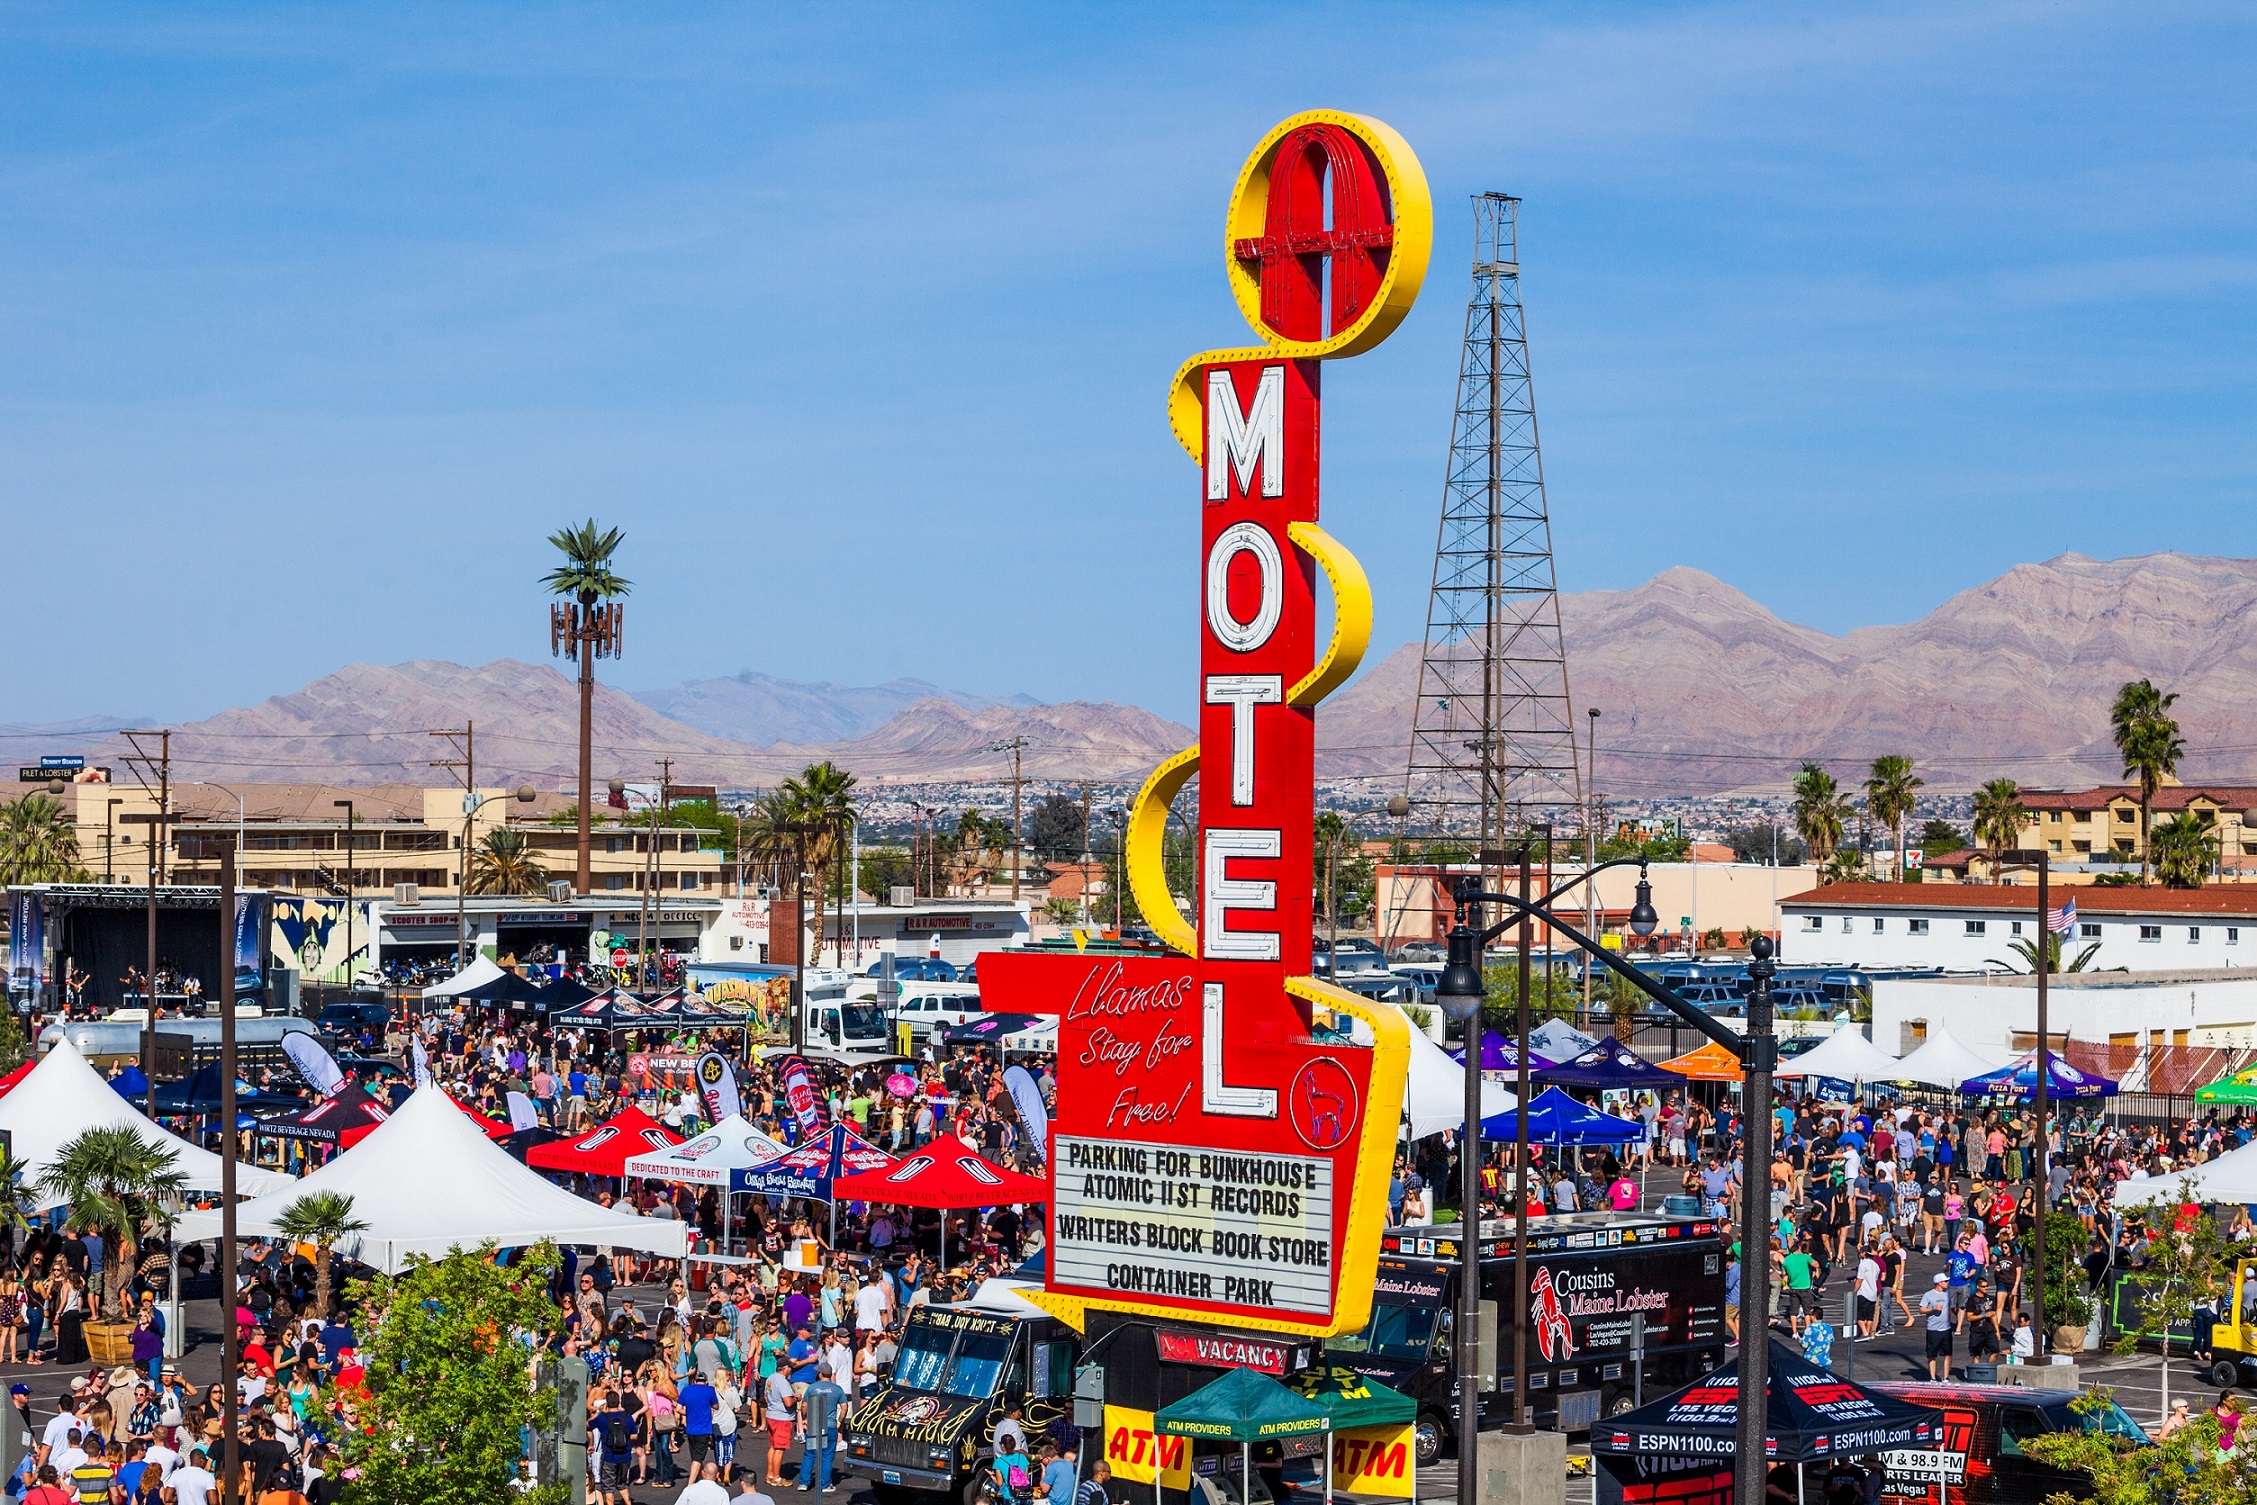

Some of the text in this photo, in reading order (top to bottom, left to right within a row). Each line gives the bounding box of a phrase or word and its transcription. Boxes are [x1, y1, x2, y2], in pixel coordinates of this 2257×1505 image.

[1203, 365, 1286, 1119] MOTEL
[22, 769, 38, 777] FILET
[45, 769, 72, 777] LOBSTER
[392, 916, 449, 925] SCOOTER SHOP
[732, 912, 765, 920] AUTOMOTIVE
[929, 916, 971, 928] AUTOMOTIVE
[613, 954, 627, 963] STOP
[1068, 961, 1193, 1023] Llamas
[1080, 1019, 1193, 1077] Stay for
[650, 1058, 679, 1069] NEW
[1988, 1082, 2029, 1094] PIZZA PORT
[1107, 1081, 1194, 1130] Free!
[259, 1123, 336, 1140] WIRTZ BEVERAGE NEVADA
[631, 1162, 720, 1180] DEDICATED TO THE CRAFT
[1069, 1143, 1316, 1190] PARKING FOR BUNKHOUSE
[837, 1184, 939, 1203] WIRTZ BEVERAGE NEVADA
[948, 1193, 976, 1203] WIRTZ
[976, 1189, 1019, 1201] BEVERAGE
[1083, 1174, 1154, 1205] ATOMIC
[1211, 1185, 1300, 1218] RECORDS
[1059, 1214, 1328, 1267] WRITERS BLOCK BOOK STORE
[1107, 1263, 1274, 1305] CONTAINER PARK
[1403, 1281, 1440, 1297] Lobster
[1555, 1266, 1615, 1297] Cousins
[1568, 1287, 1669, 1317] Maine Lobster
[1196, 1338, 1288, 1369] VACANCY
[1792, 1384, 1865, 1406] ESPN
[1811, 1399, 1876, 1413] LAS VEGAS
[1167, 1421, 1232, 1436] ATM PROVIDERS
[1259, 1419, 1321, 1435] ATM PROVIDERS
[1834, 1429, 1911, 1450] ESPN1100.com
[1109, 1427, 1185, 1471] ATM
[1332, 1437, 1407, 1478] ATM
[1897, 1453, 1908, 1466] &
[1911, 1454, 1938, 1468] 98.9
[1943, 1456, 1962, 1469] FM
[1896, 1483, 1926, 1496] Vegas
